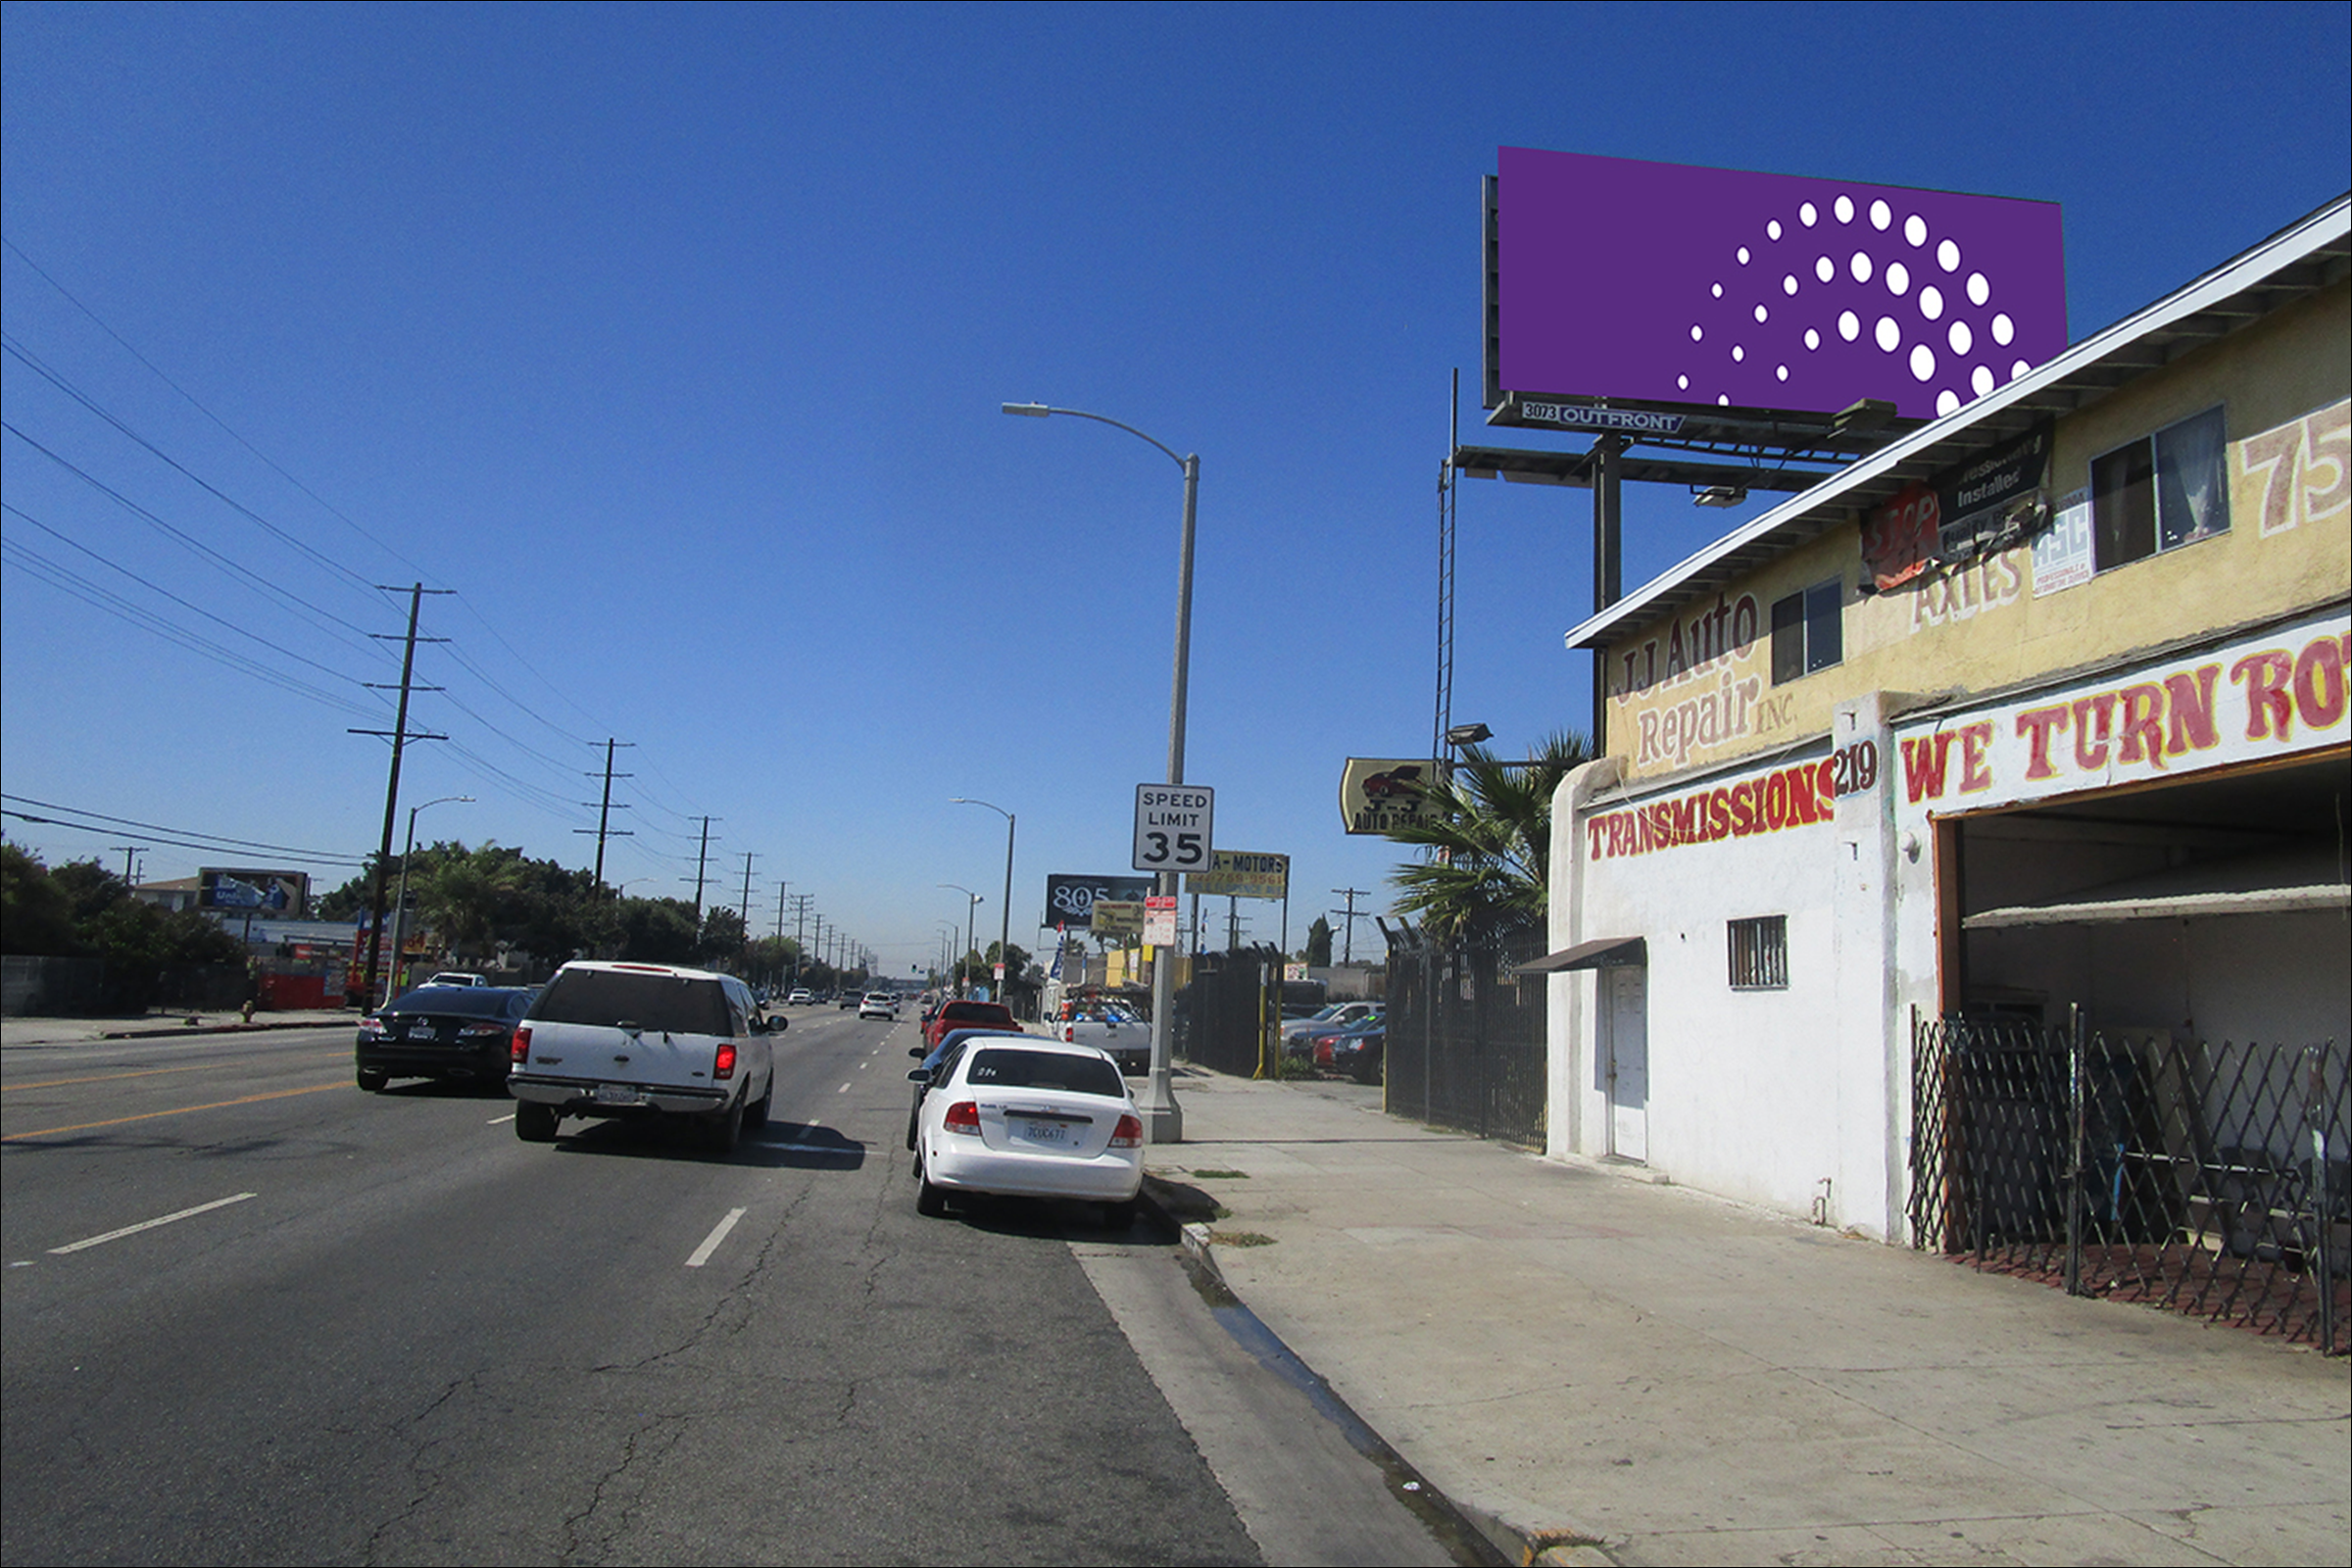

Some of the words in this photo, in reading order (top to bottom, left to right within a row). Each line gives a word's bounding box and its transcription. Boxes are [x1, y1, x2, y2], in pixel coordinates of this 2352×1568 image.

[1525, 404, 1557, 419] 3073
[1563, 408, 1677, 430] OUTFRONT
[1870, 495, 1936, 552] STOP
[1909, 549, 2023, 635] AXLES
[1660, 592, 1760, 693] Auto
[1638, 669, 1762, 770] Repair
[1899, 718, 1994, 805] WE
[2015, 662, 2224, 771] TURN
[1834, 739, 1878, 798] 219
[1143, 792, 1207, 808] SPEED
[1149, 812, 1200, 827] LIMIT
[1354, 812, 1388, 830] AUTO
[1588, 757, 1836, 861] TRANSMISSIONS
[1143, 832, 1202, 864] 35
